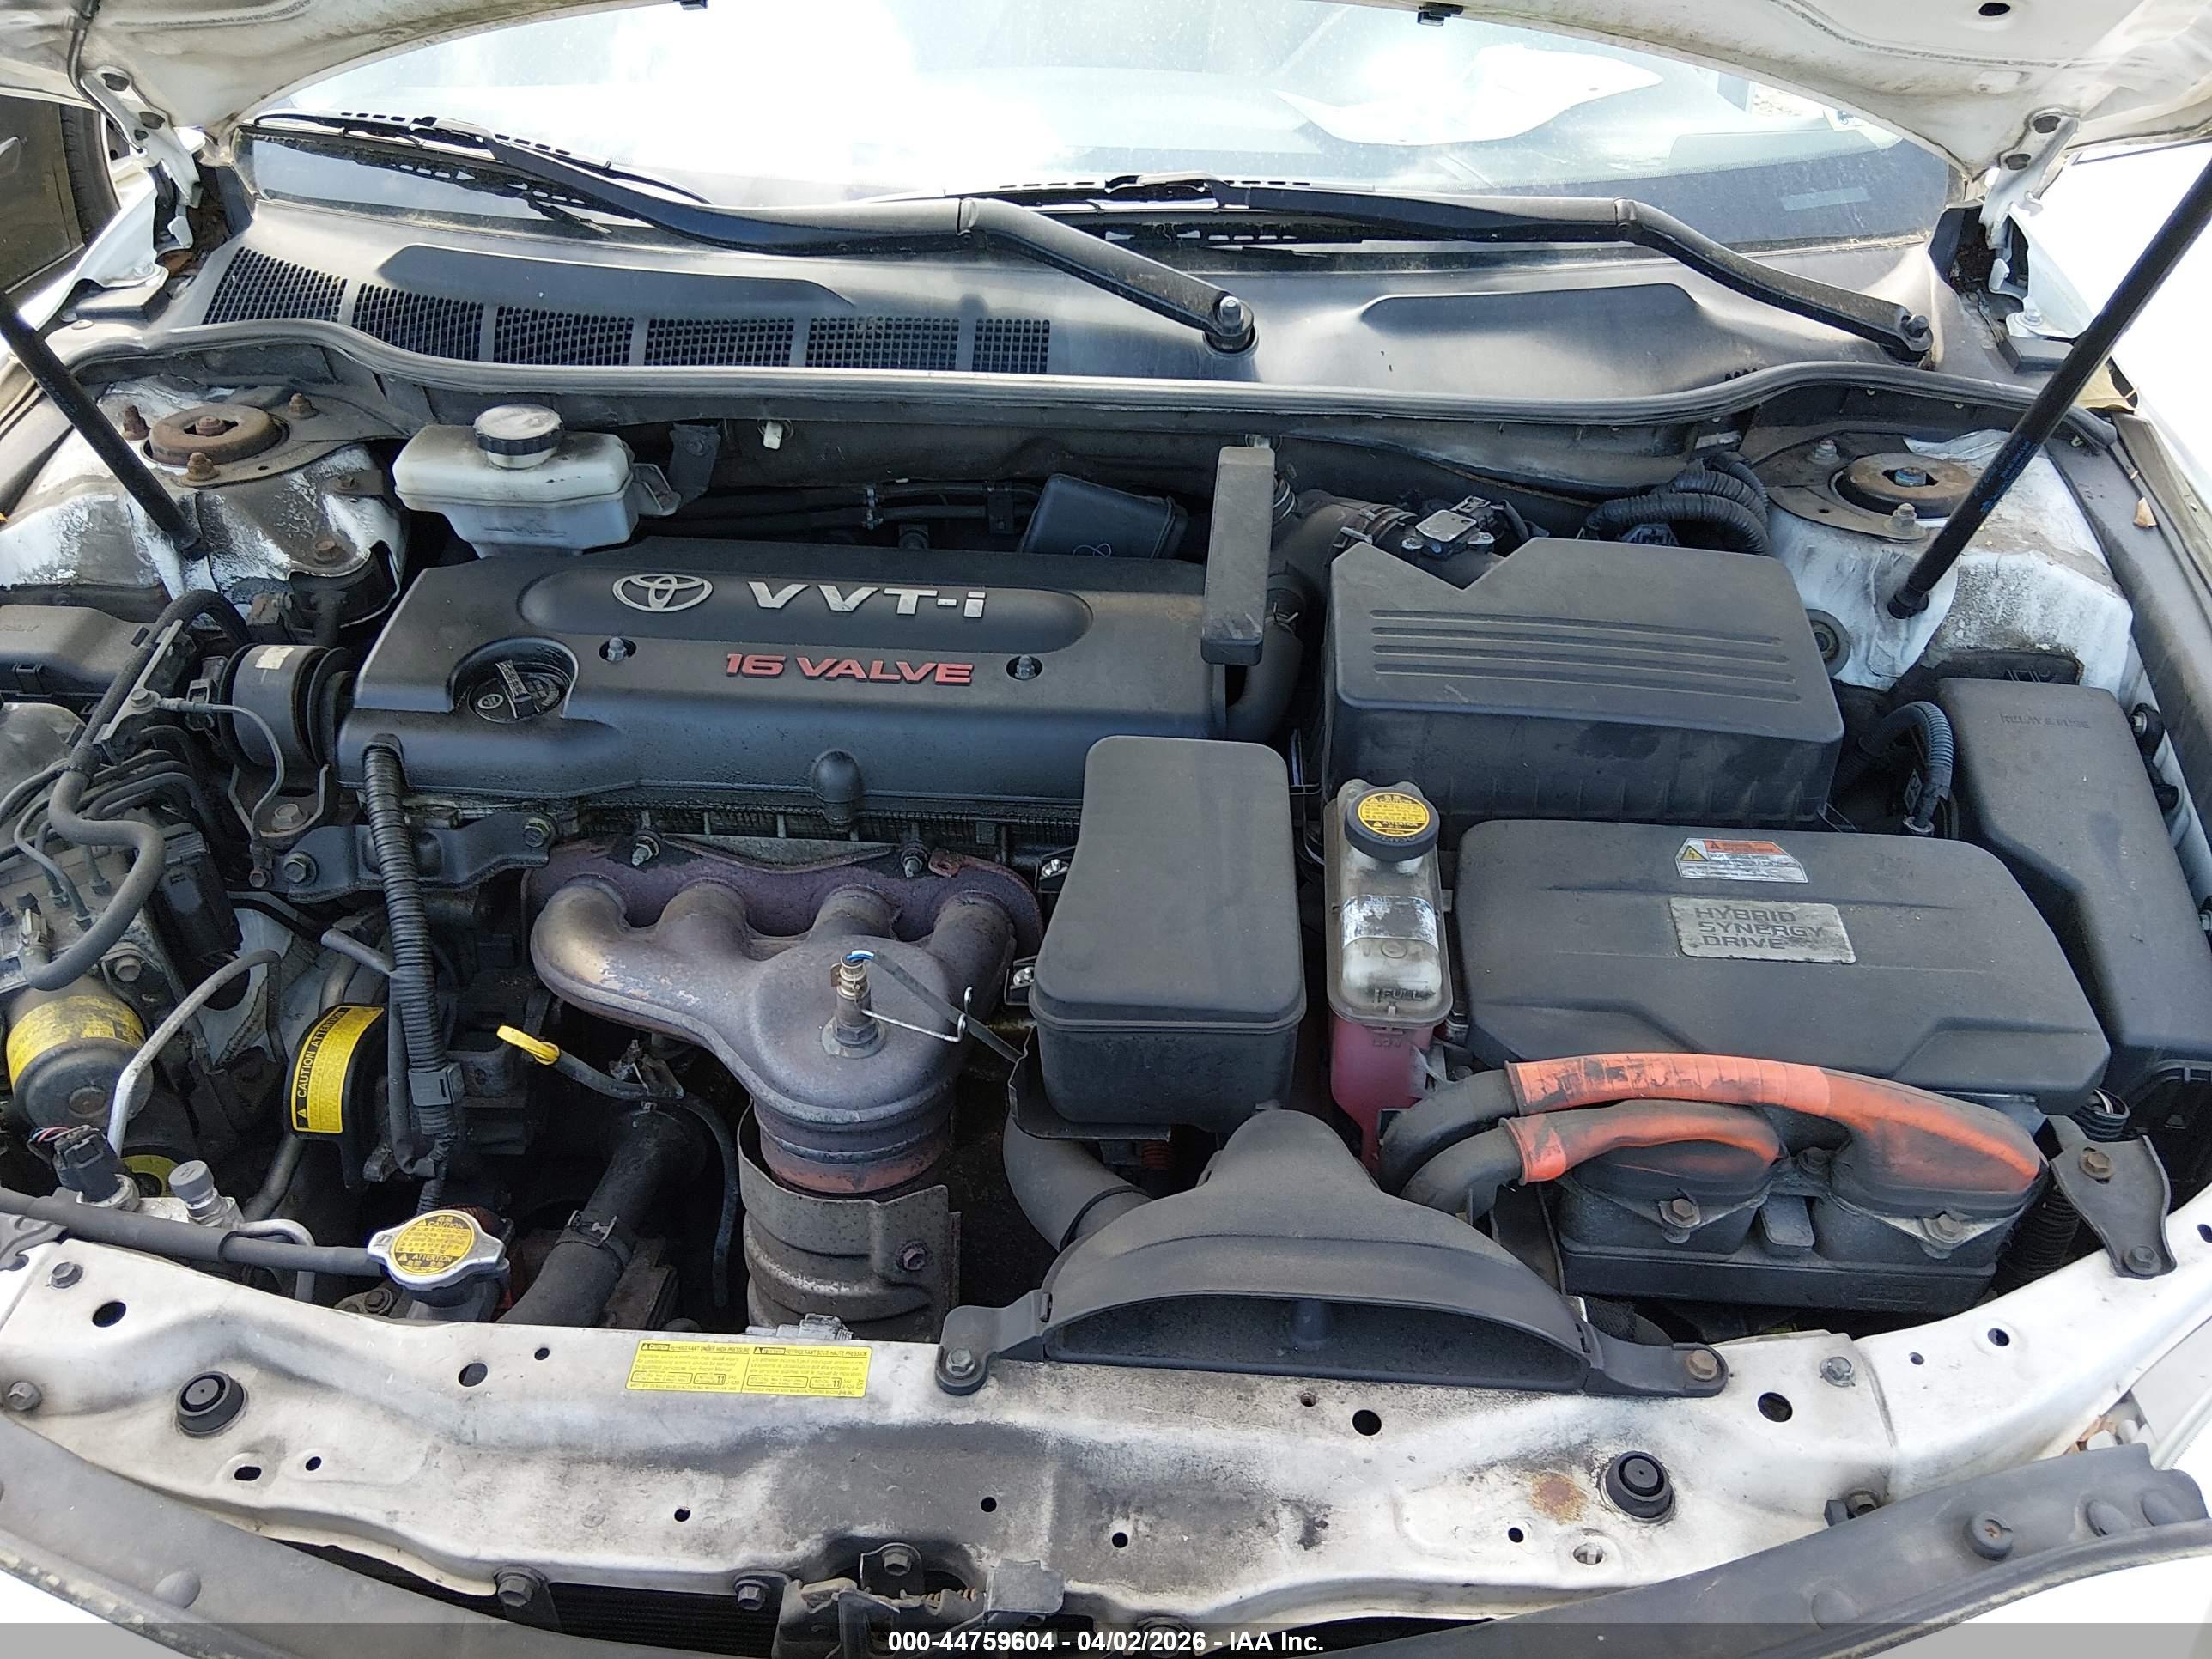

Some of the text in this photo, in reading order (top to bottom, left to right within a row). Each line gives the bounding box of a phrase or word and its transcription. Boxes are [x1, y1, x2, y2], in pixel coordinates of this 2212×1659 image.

[747, 580, 987, 617] VVT-i
[726, 653, 974, 685] 16 VALVE
[1695, 907, 1797, 922] HYBRID
[1697, 921, 1824, 937] SYNERGY
[1702, 935, 1786, 950] DRIVE
[1382, 988, 1424, 1001] FULL
[296, 1050, 316, 1098] CAUTION
[310, 1011, 346, 1048] ATTENTION
[412, 1254, 453, 1263] ATTENTION
